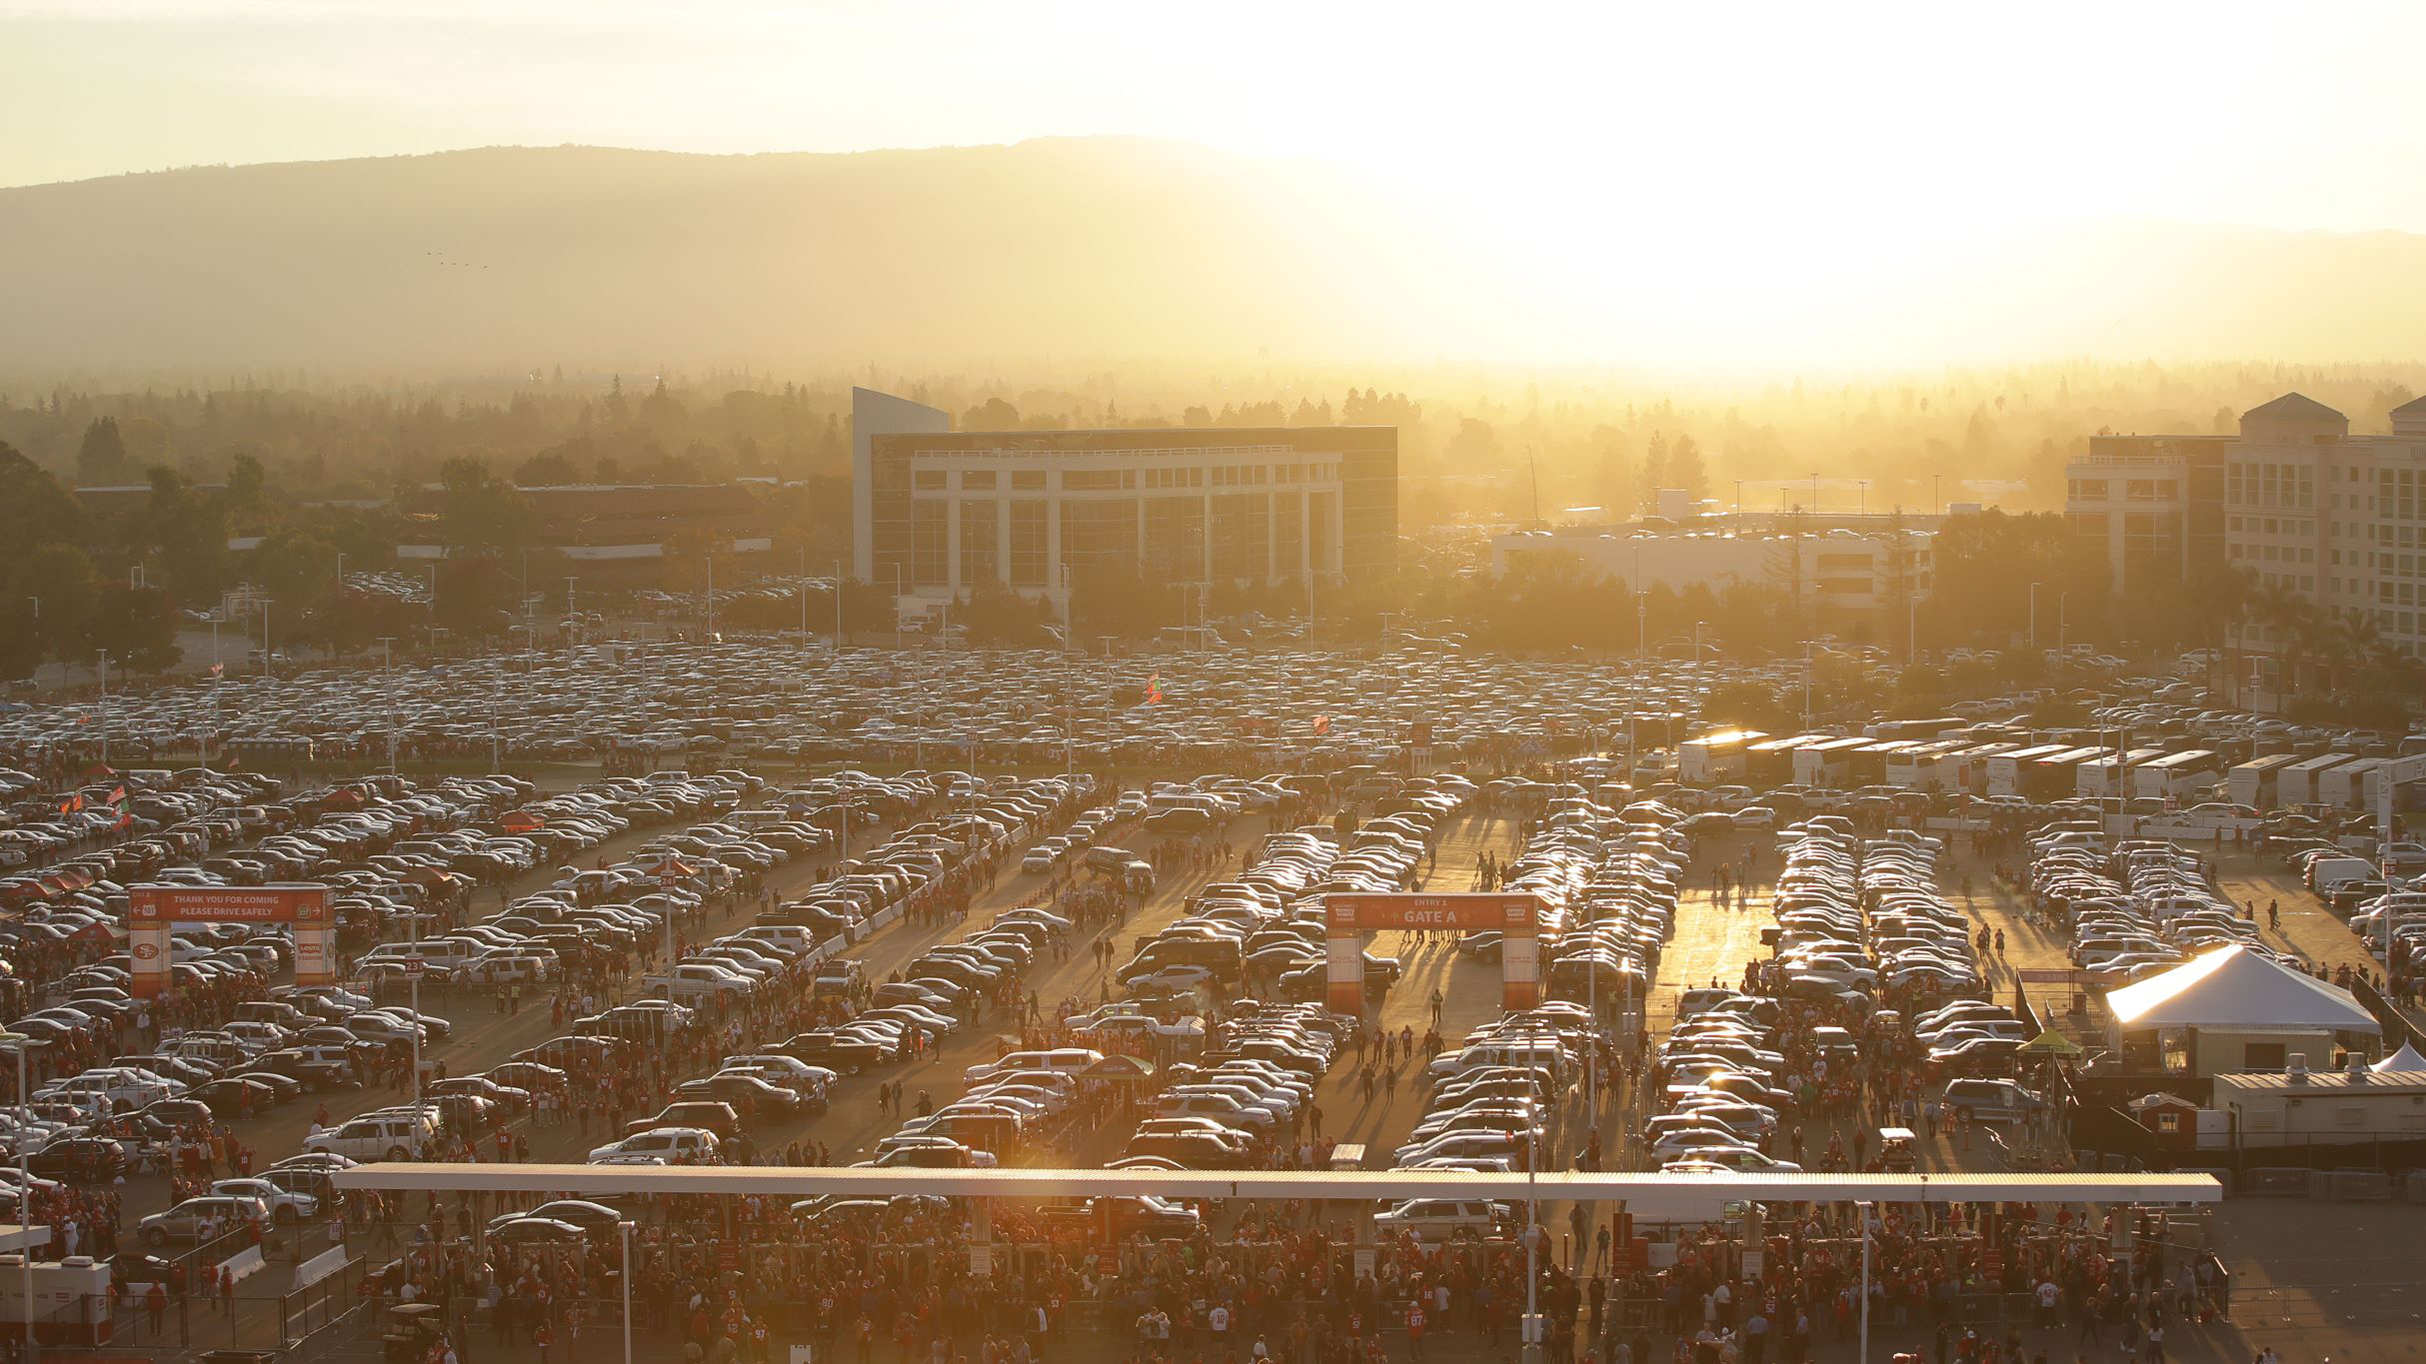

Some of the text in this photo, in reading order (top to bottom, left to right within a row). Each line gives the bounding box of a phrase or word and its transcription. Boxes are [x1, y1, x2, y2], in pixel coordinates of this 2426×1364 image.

[2384, 865, 2395, 873] 35
[662, 877, 673, 885] 24
[174, 895, 279, 904] THANK YOU FOR COMING
[180, 907, 273, 916] PLEASE DRIVE SAFELY
[1404, 910, 1457, 923] GATE A
[406, 961, 418, 971] 23
[1424, 1290, 1434, 1300] 16
[822, 1297, 834, 1308] 80
[1765, 1302, 1776, 1313] 52
[1216, 1314, 1226, 1324] 10
[1411, 1315, 1423, 1327] 87
[755, 1329, 766, 1339] 97
